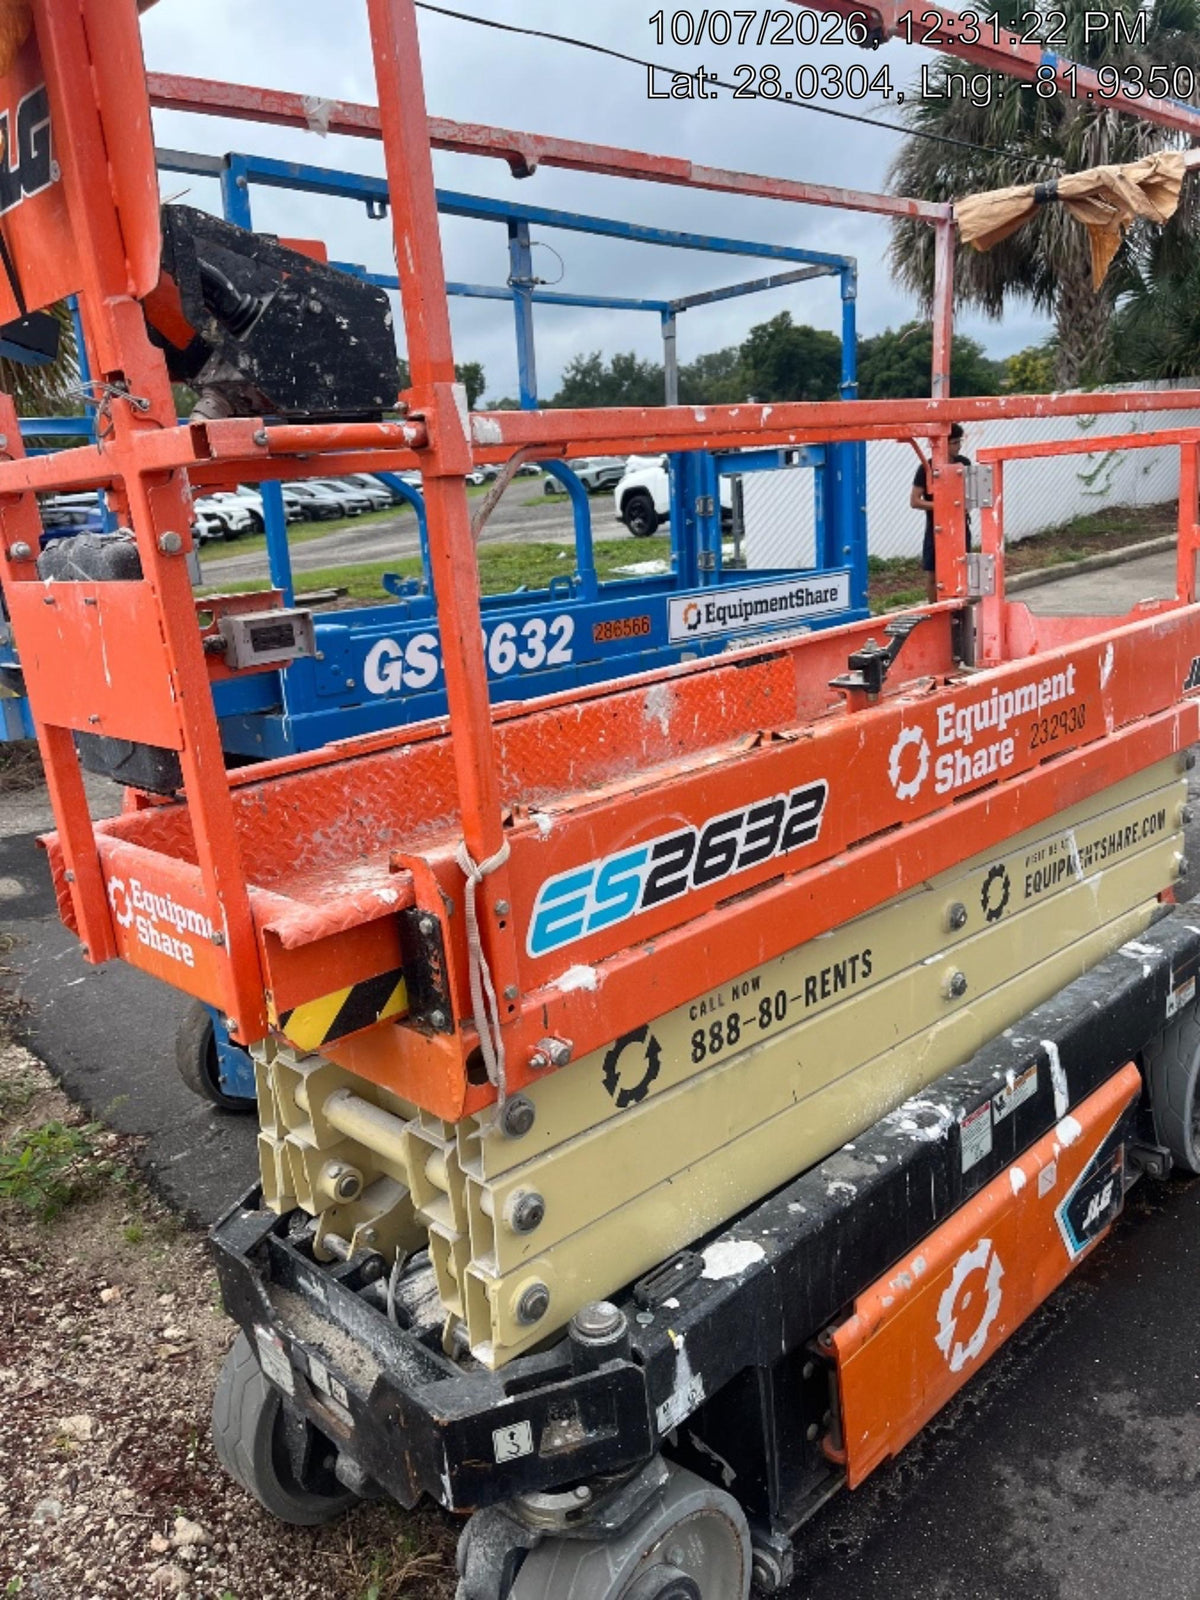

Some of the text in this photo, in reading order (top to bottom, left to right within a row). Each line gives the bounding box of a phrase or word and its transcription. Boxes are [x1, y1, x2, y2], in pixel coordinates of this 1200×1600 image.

[595, 616, 650, 641] 286566
[705, 587, 838, 626] EquipmentShare
[363, 614, 575, 694] GS632
[936, 663, 1076, 746] Equipment
[1030, 703, 1086, 749] 232930
[934, 736, 1015, 795] Share
[526, 778, 829, 959] ES2632
[129, 878, 213, 940] Equipm
[136, 914, 195, 967] Share
[690, 976, 761, 1021] CALL NOW
[691, 949, 872, 1064] 888-80-RENTS
